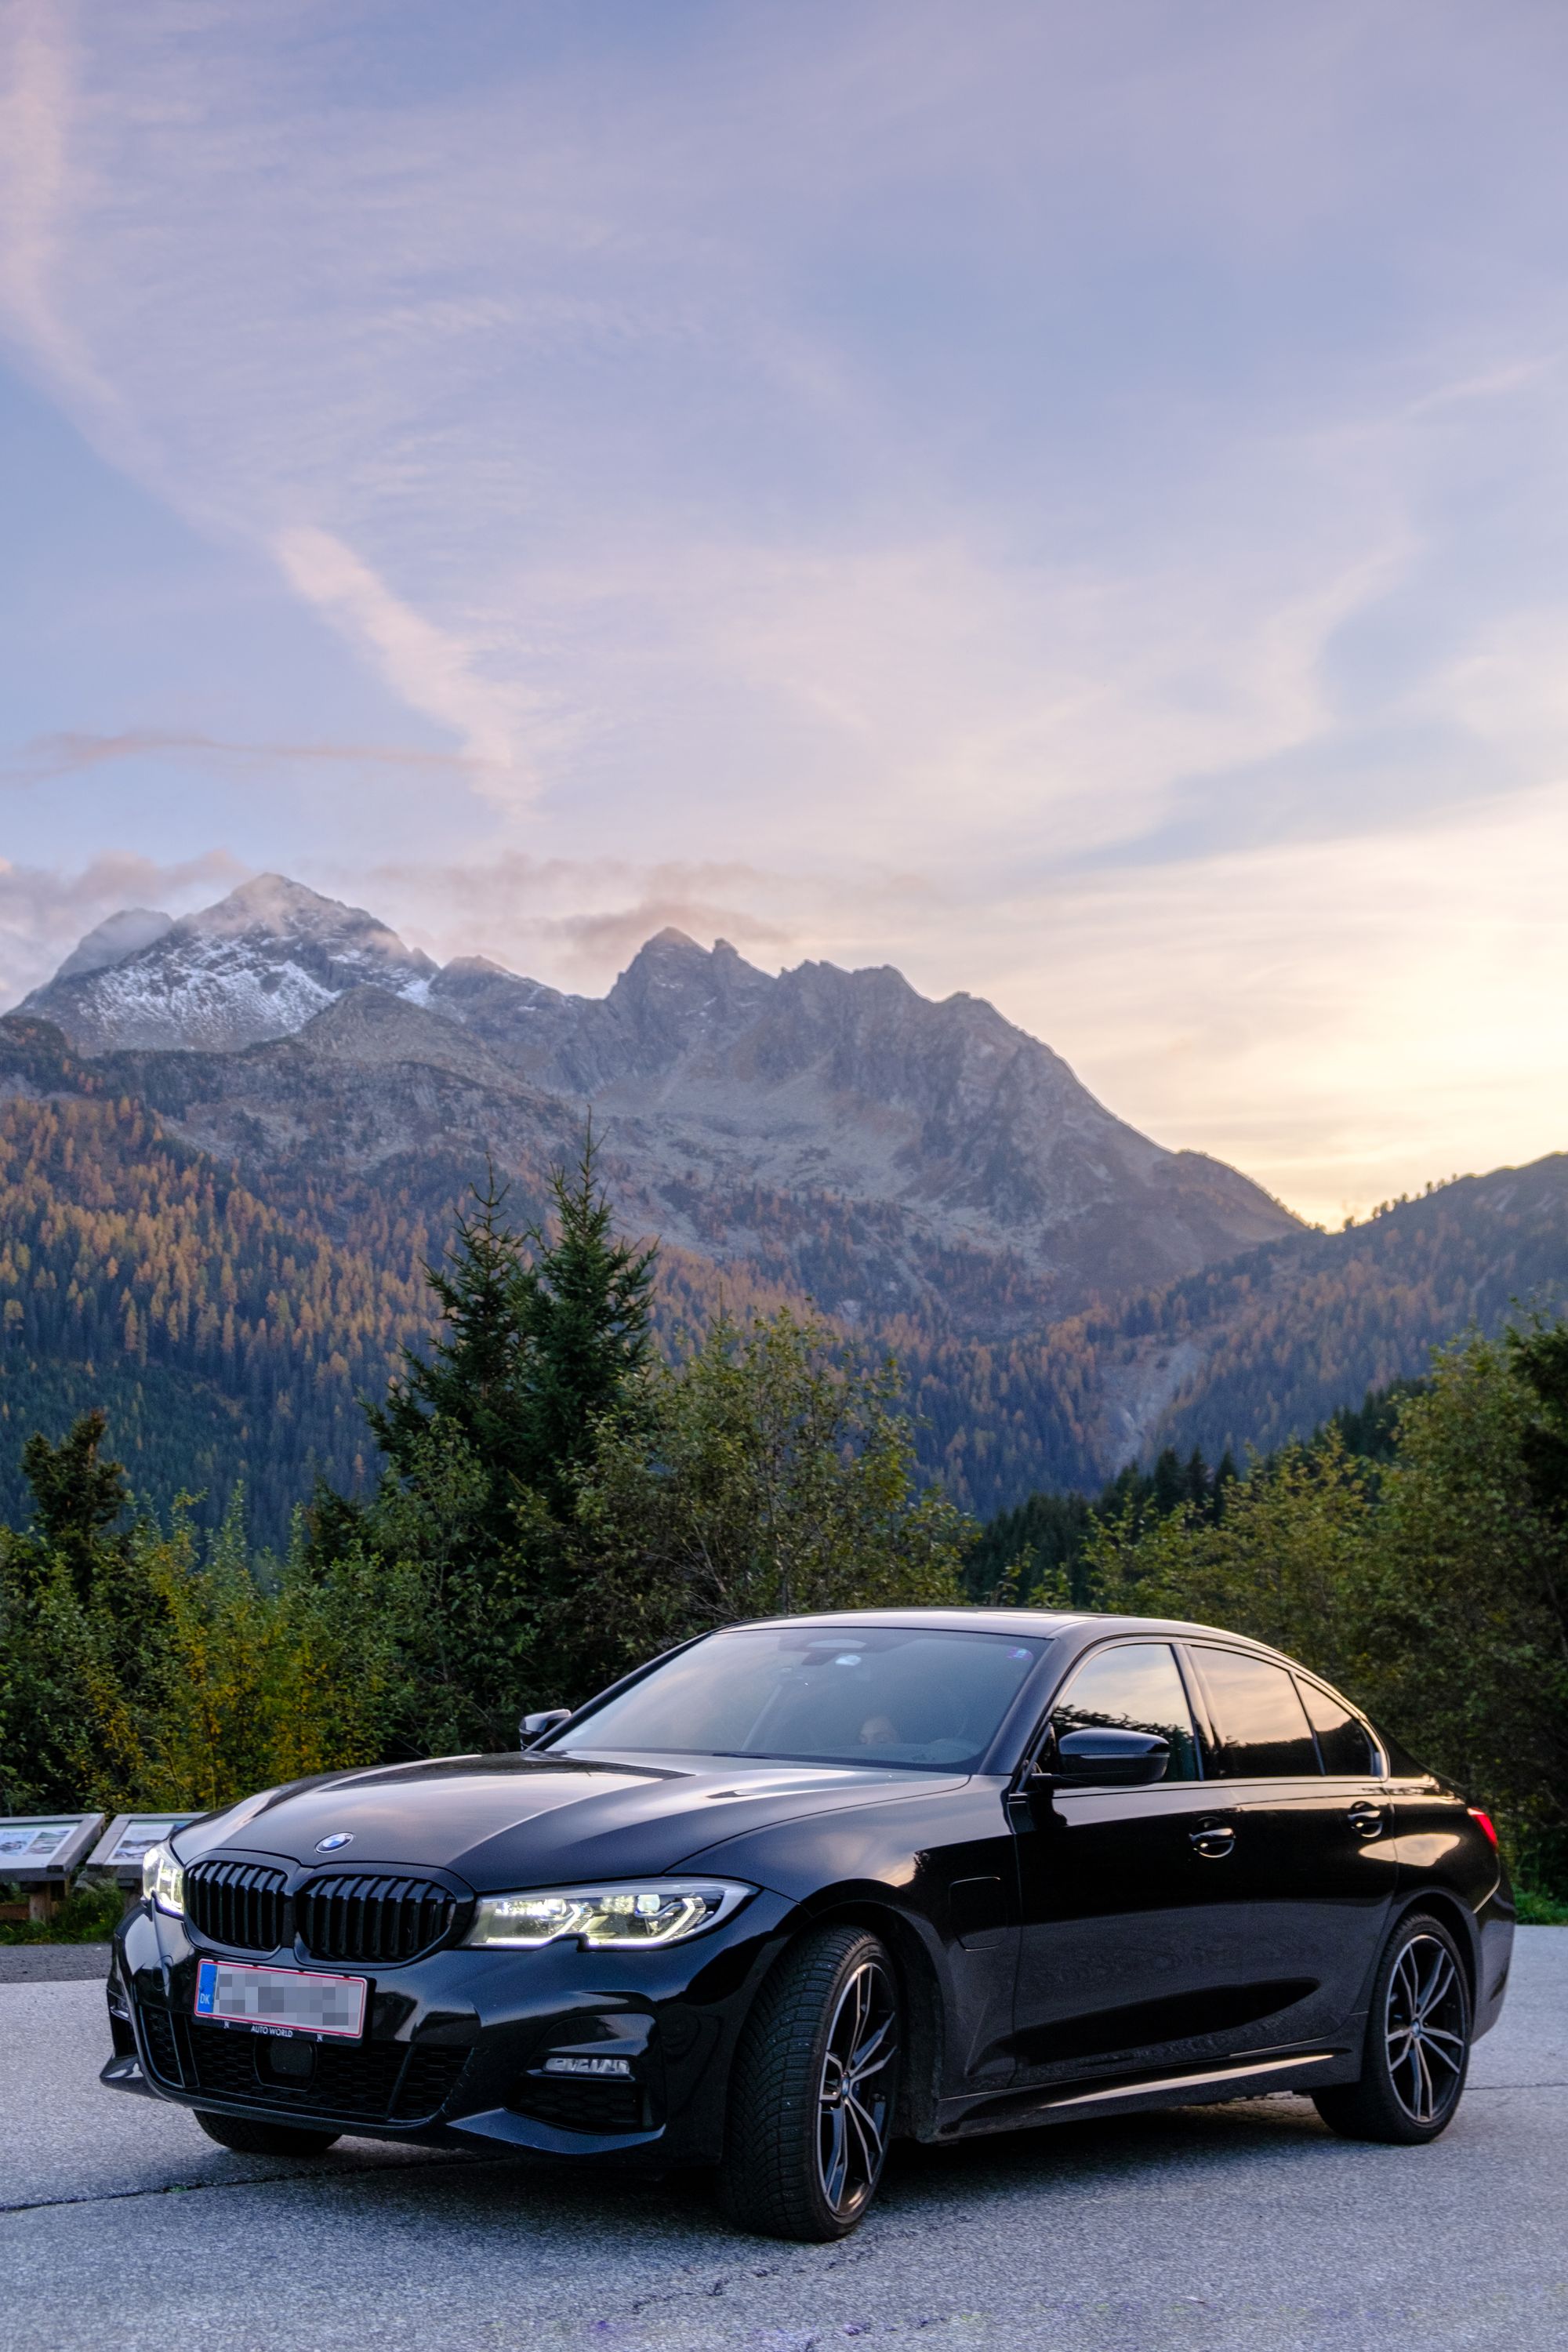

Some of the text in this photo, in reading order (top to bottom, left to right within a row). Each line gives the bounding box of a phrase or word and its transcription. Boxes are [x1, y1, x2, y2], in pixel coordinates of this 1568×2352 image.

[200, 1993, 211, 2005] DK
[251, 2025, 293, 2038] AUTO WORLD
